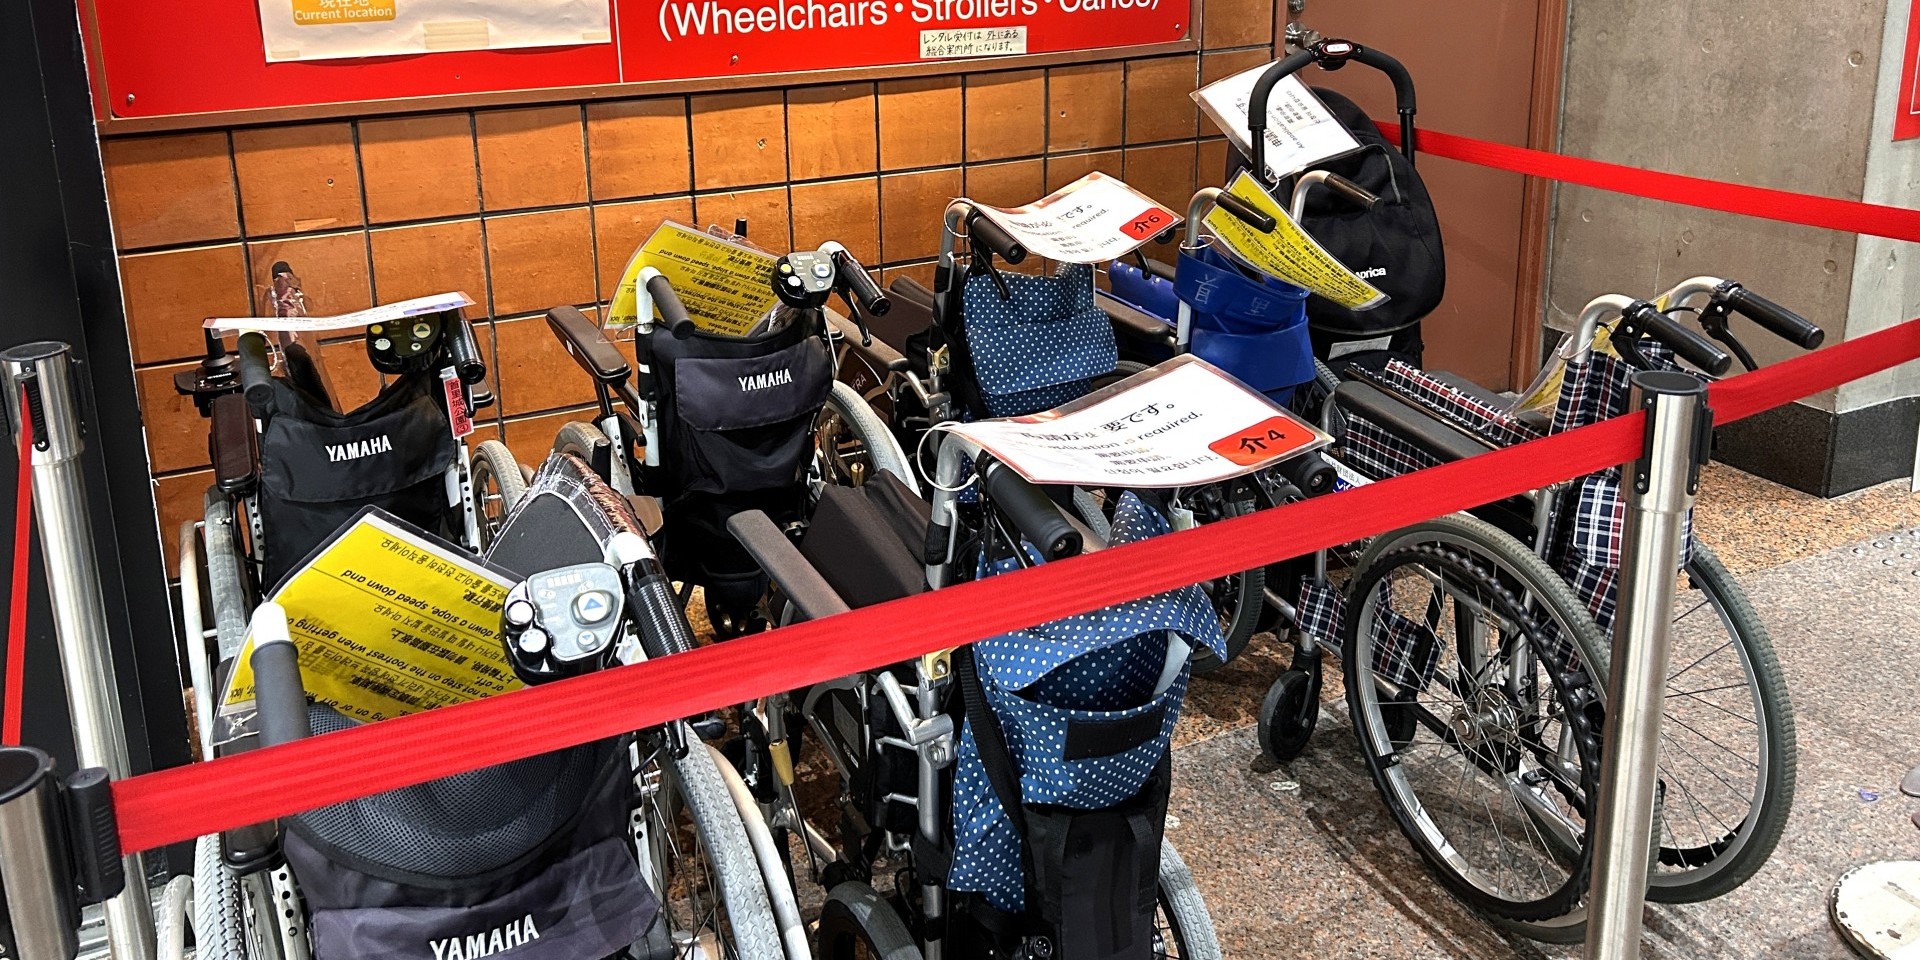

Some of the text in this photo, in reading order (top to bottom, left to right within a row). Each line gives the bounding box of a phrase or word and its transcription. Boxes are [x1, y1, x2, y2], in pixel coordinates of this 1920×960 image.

[294, 8, 392, 20] Current location
[1072, 208, 1110, 230] required.
[1133, 214, 1161, 233] 介6
[1207, 219, 1218, 230] lock
[673, 253, 690, 262] down
[690, 259, 709, 268] speed
[710, 264, 728, 274] slope,
[734, 272, 750, 280] down
[738, 368, 792, 392] YAMAHA
[1138, 410, 1203, 440] required.
[325, 435, 392, 462] YAMAHA
[1239, 430, 1286, 454] 介4
[380, 536, 430, 565] 움직이세요.
[340, 569, 367, 584] and
[426, 558, 457, 578] 천천히
[365, 579, 397, 598] down
[394, 592, 429, 611] speed
[372, 602, 403, 622] 마세요.
[428, 605, 460, 624] slope,
[293, 619, 339, 641] getting
[466, 622, 494, 639] down
[336, 636, 367, 656] when
[365, 649, 409, 670] footrest
[408, 665, 427, 679] the
[425, 672, 442, 683] on
[440, 676, 465, 691] step
[461, 686, 481, 698] not
[473, 676, 504, 692] or off.
[229, 688, 244, 699] lock
[429, 914, 540, 960] YAMAHA
